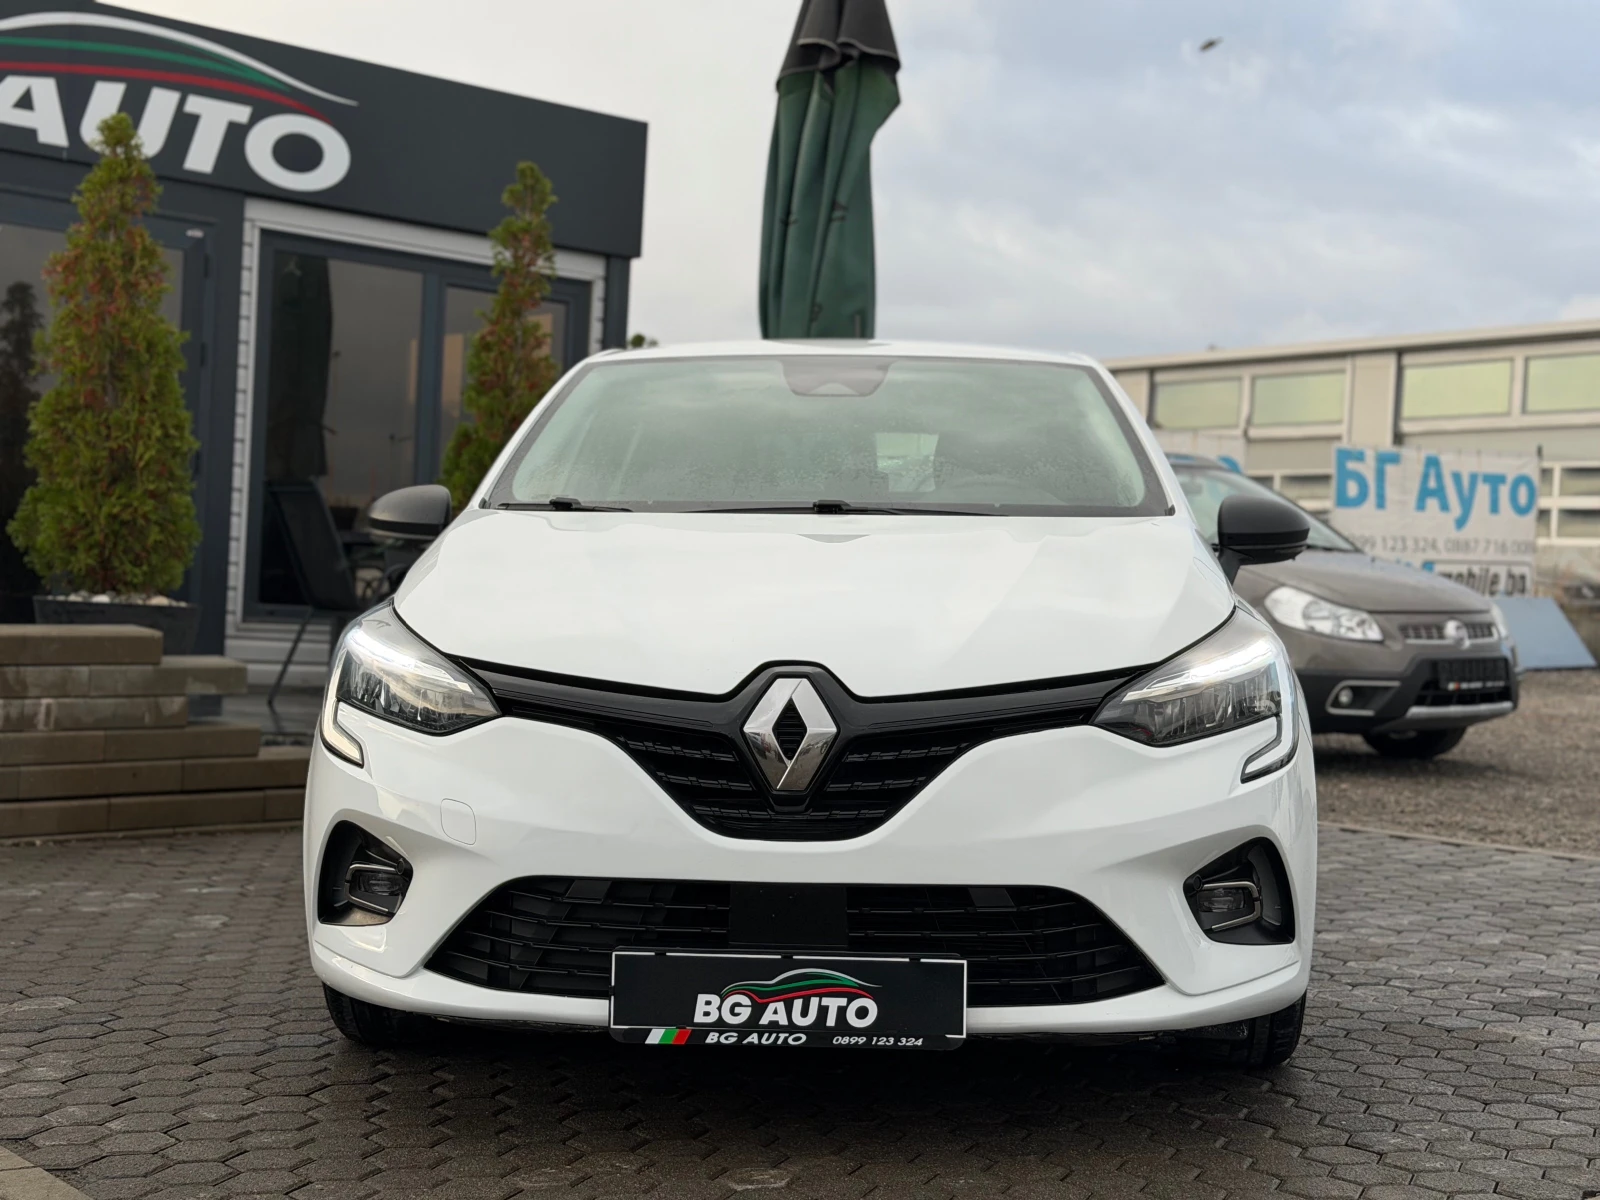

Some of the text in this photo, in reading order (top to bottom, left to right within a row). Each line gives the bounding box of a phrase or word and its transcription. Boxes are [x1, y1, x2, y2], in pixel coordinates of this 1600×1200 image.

[0, 75, 351, 192] AUTO
[1335, 448, 1536, 531] БГ Ауто
[1381, 535, 1409, 554] 123
[693, 993, 878, 1028] BG AUTO
[705, 1031, 924, 1047] BG AUTO 0899 123 324
